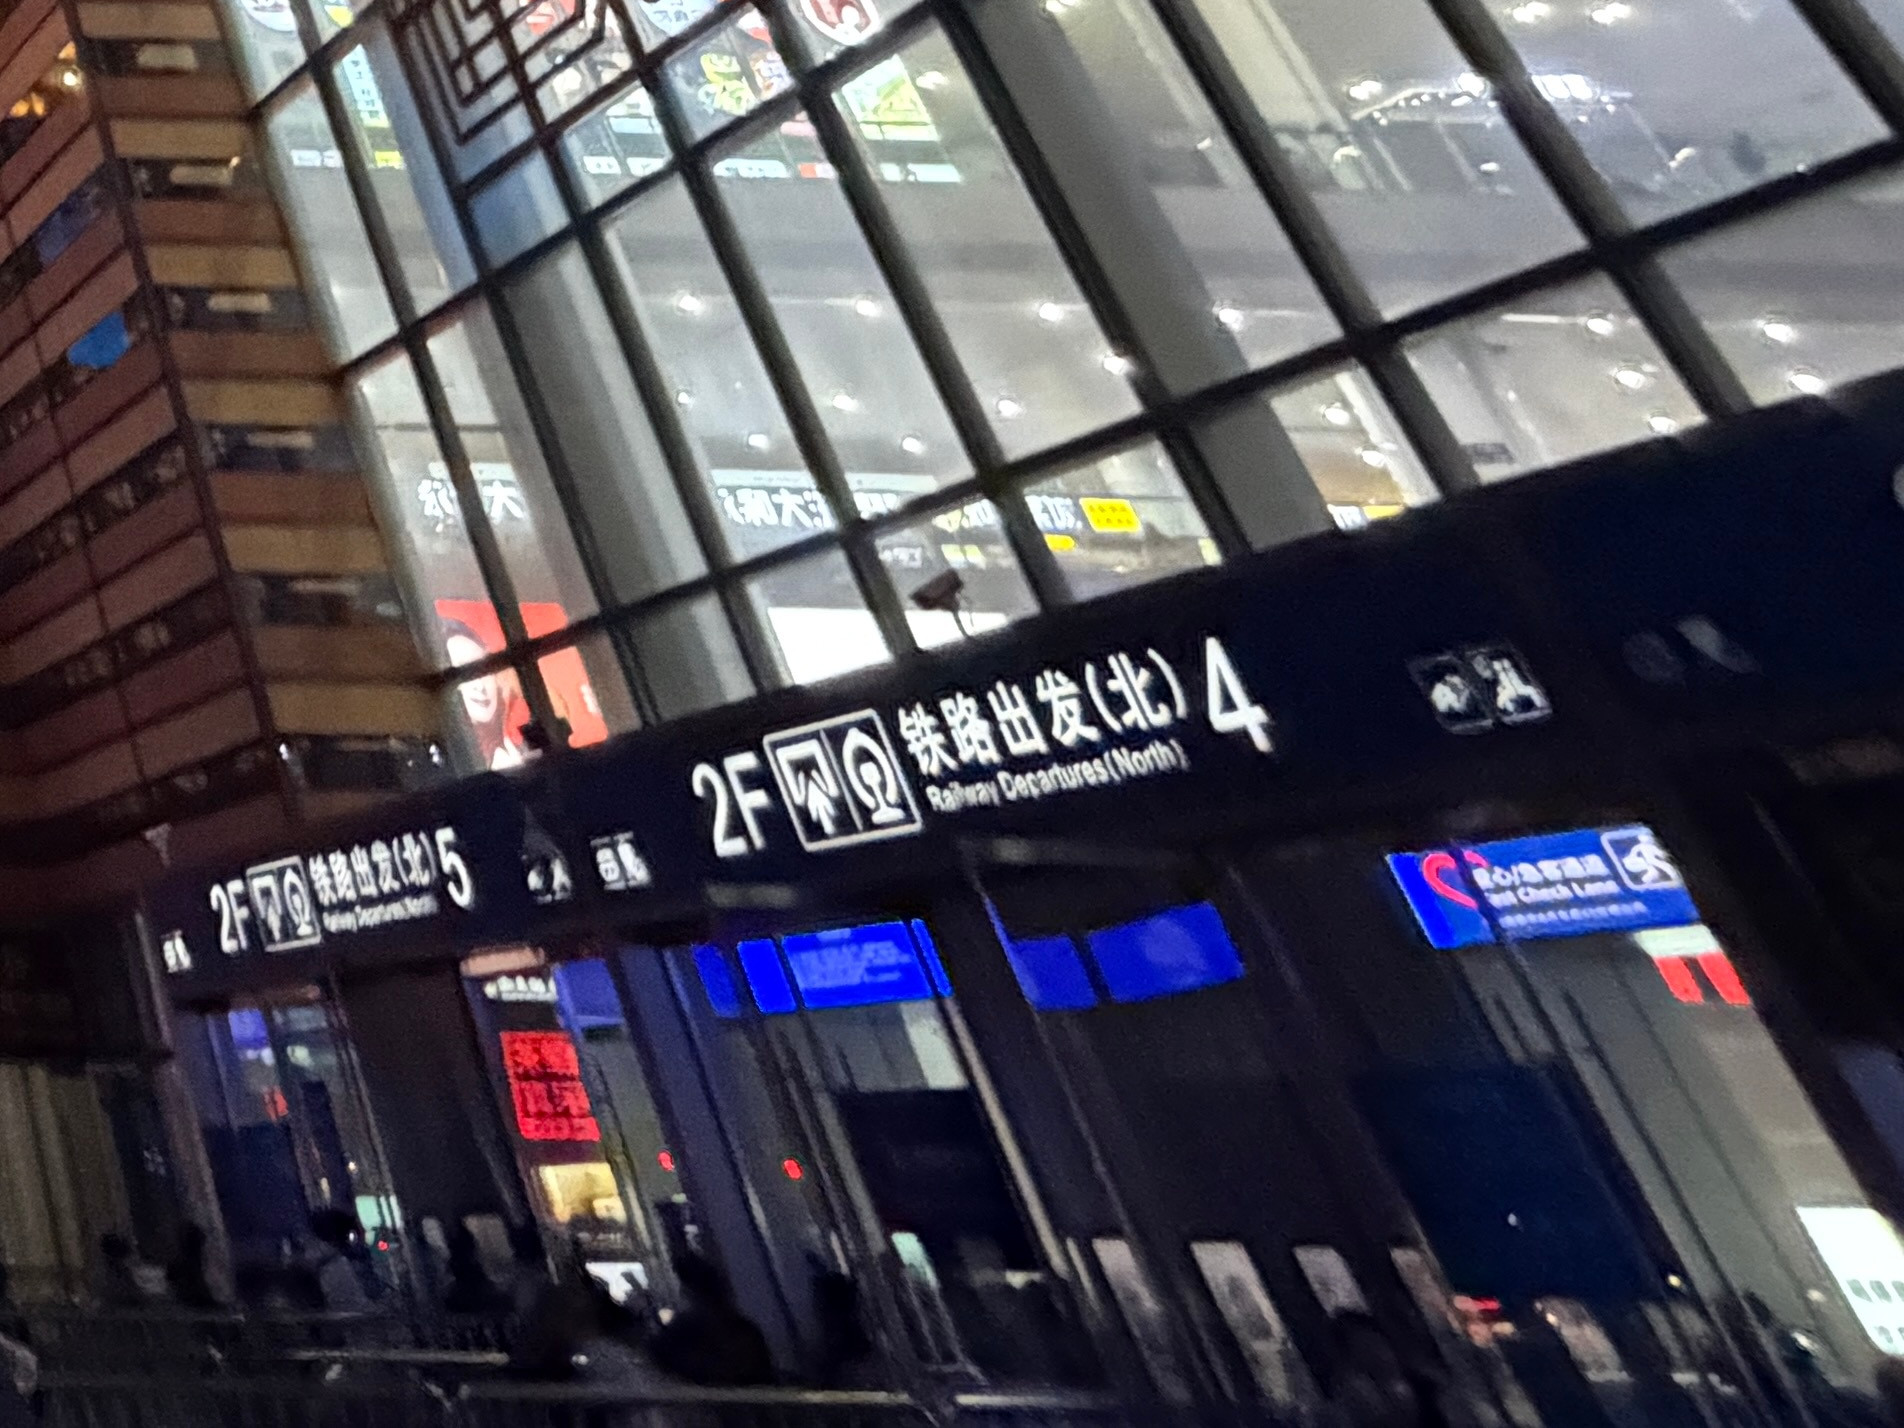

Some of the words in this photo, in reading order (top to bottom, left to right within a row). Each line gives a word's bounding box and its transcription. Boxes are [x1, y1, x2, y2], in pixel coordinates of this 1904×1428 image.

[692, 750, 775, 857] 2F
[898, 647, 1188, 776] 铁路出发(北)
[1204, 636, 1274, 754] 4
[925, 777, 1001, 814] Railway
[210, 878, 250, 955] 2F
[308, 831, 438, 907] 铁路出发(北)
[435, 826, 475, 911] 5
